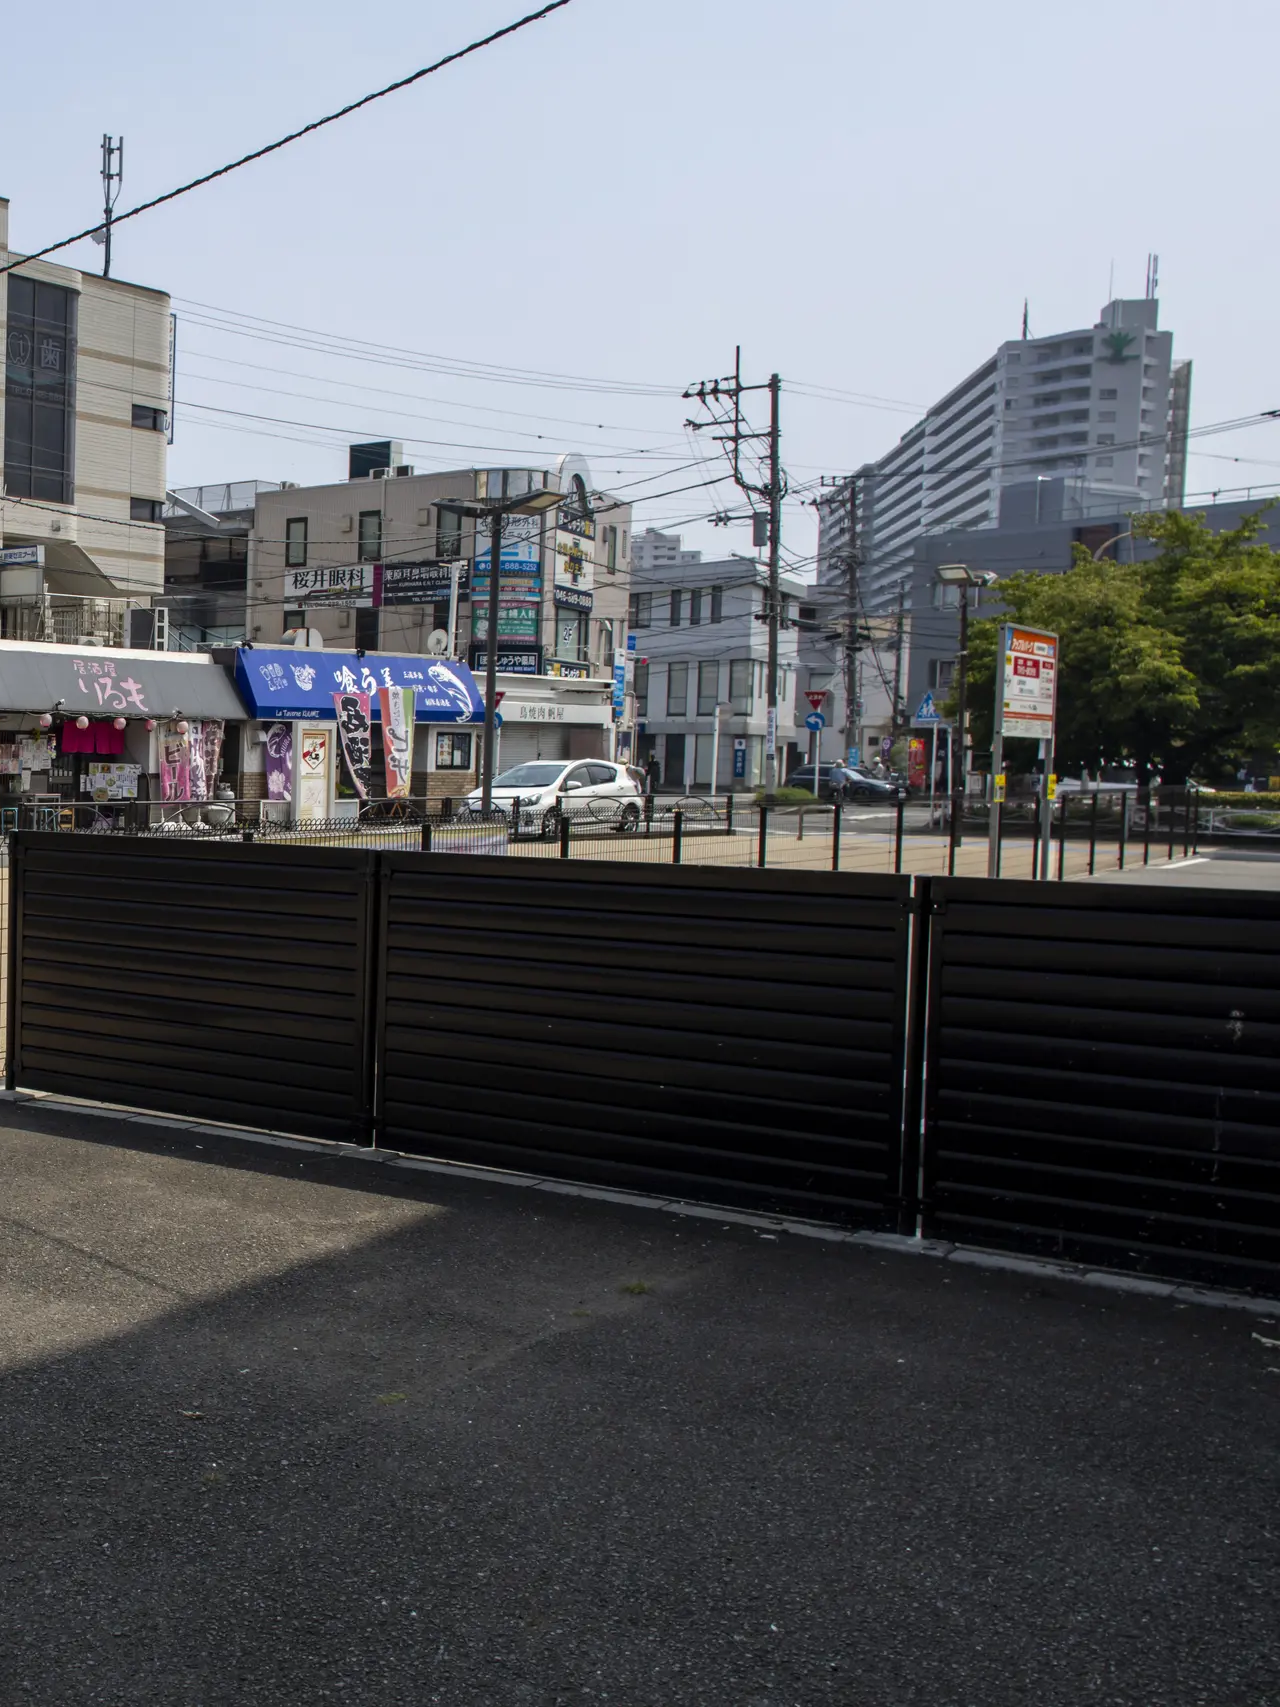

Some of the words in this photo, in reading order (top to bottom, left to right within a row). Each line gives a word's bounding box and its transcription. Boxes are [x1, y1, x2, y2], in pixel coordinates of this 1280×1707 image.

[486, 562, 537, 571] 0-888-5252
[292, 568, 366, 590] 桜井眼科
[73, 660, 117, 676] 居酒屋
[164, 742, 184, 801] ビール
